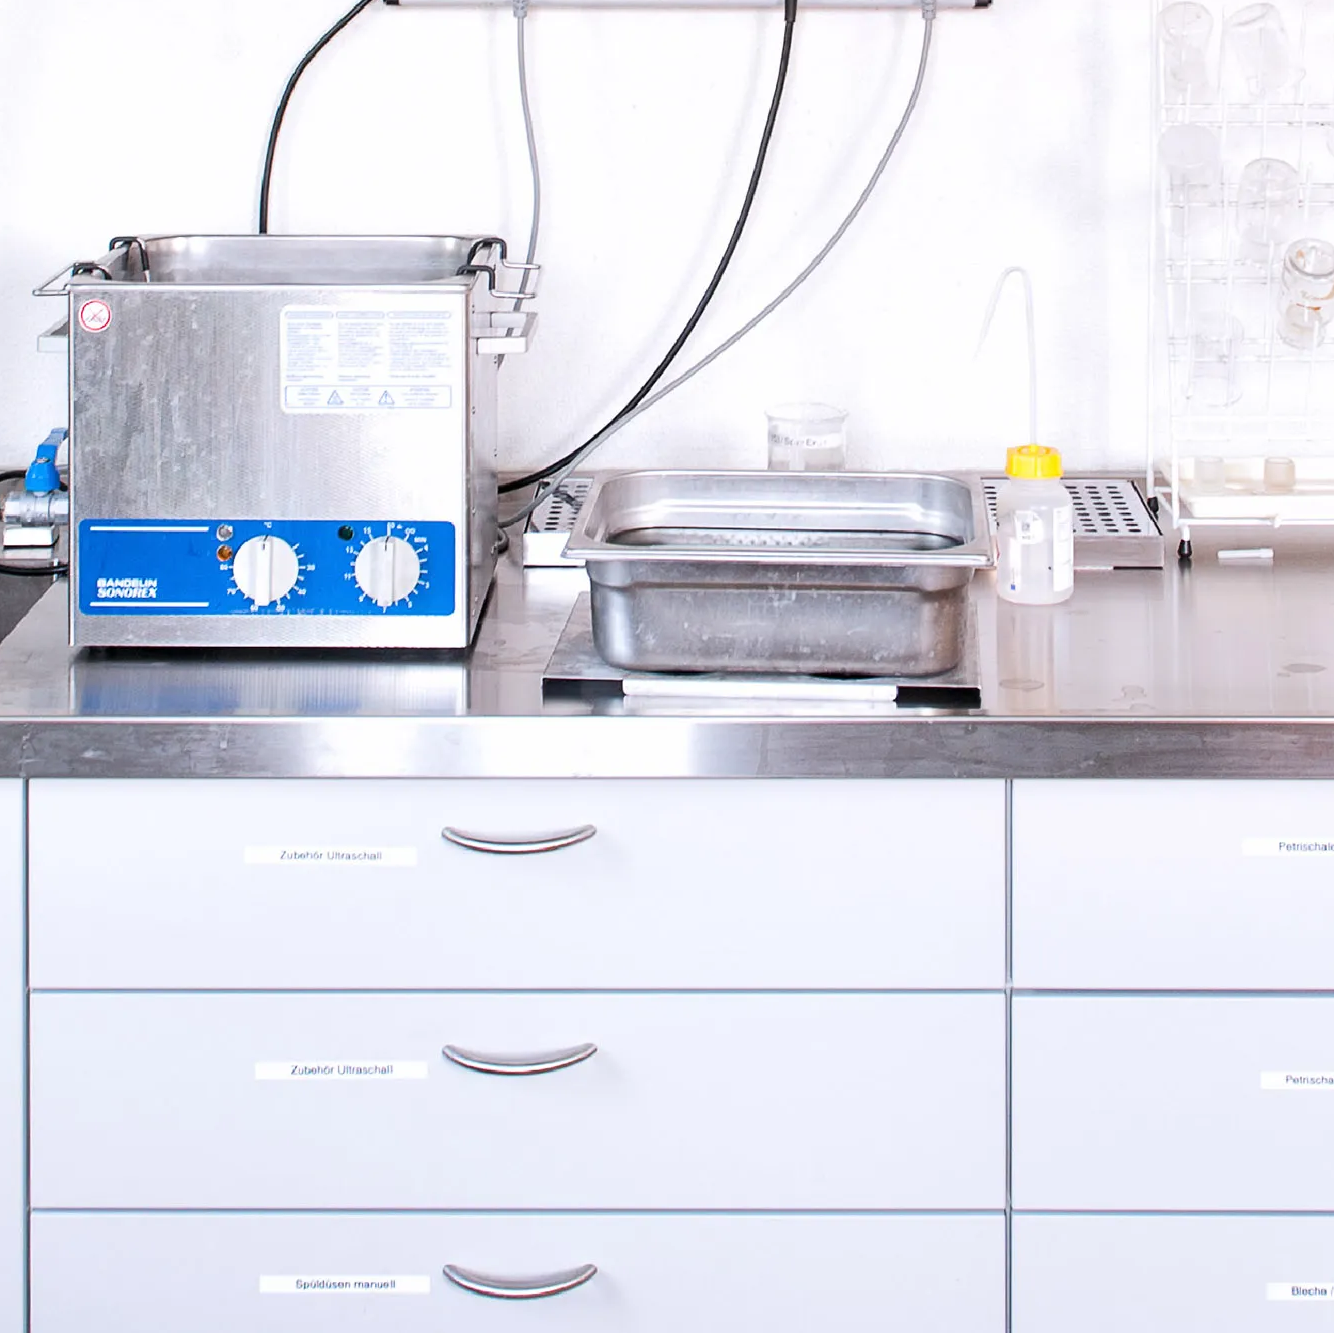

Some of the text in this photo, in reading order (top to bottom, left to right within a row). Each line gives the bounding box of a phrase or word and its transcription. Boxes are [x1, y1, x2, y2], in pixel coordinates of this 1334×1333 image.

[97, 578, 158, 587] BANDELIN
[97, 587, 158, 599] SONOREX
[327, 850, 383, 861] Ultraschall
[337, 1064, 394, 1075] Ultraschall
[353, 1279, 396, 1289] manuell
